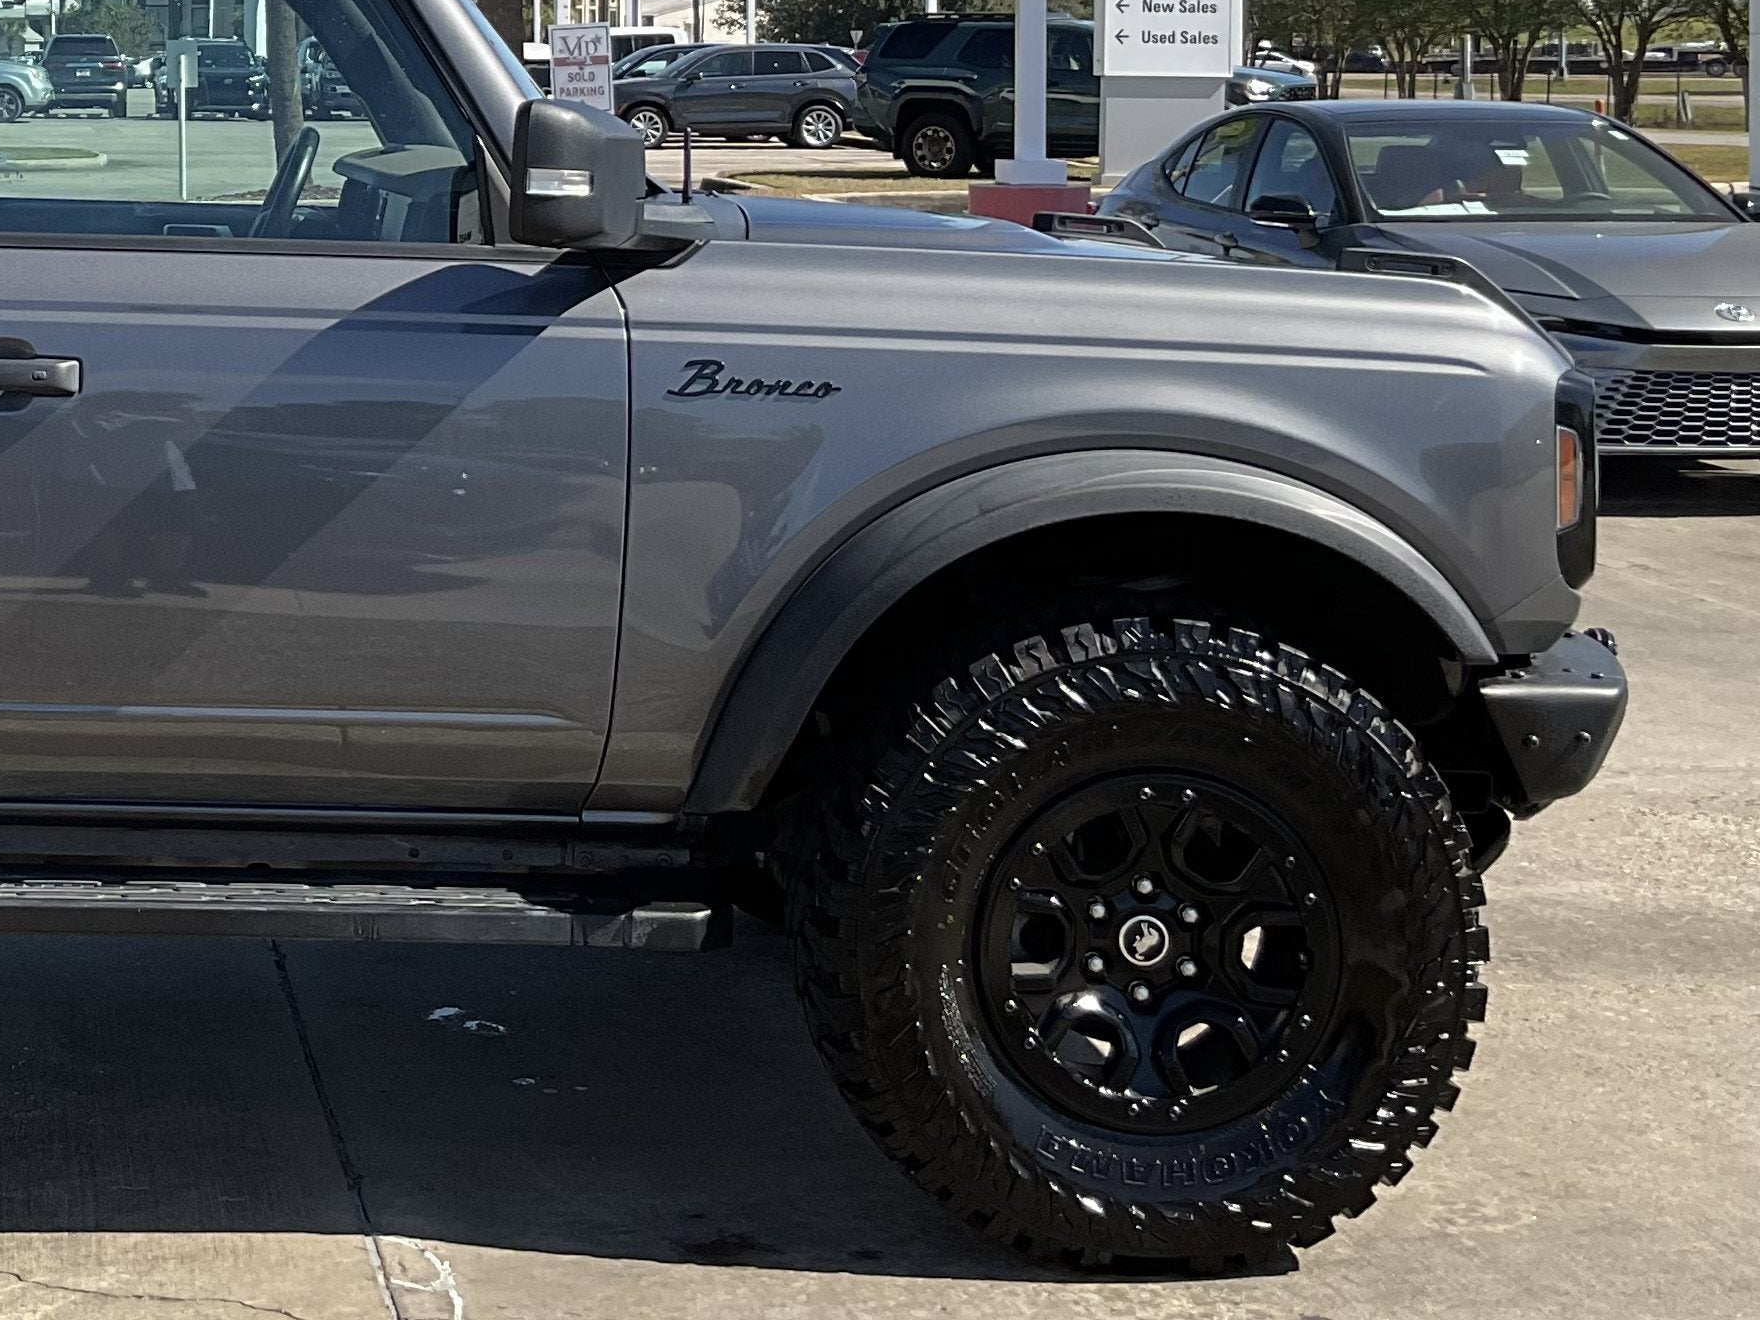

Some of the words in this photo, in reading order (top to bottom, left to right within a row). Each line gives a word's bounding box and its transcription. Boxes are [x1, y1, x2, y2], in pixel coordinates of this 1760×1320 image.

[1142, 0, 1175, 13] New
[1179, 0, 1217, 14] Sales
[1141, 30, 1175, 45] Used
[1180, 30, 1219, 45] Sales
[567, 71, 595, 83] SOLD
[559, 86, 605, 98] PARKING
[667, 359, 842, 398] Bronco
